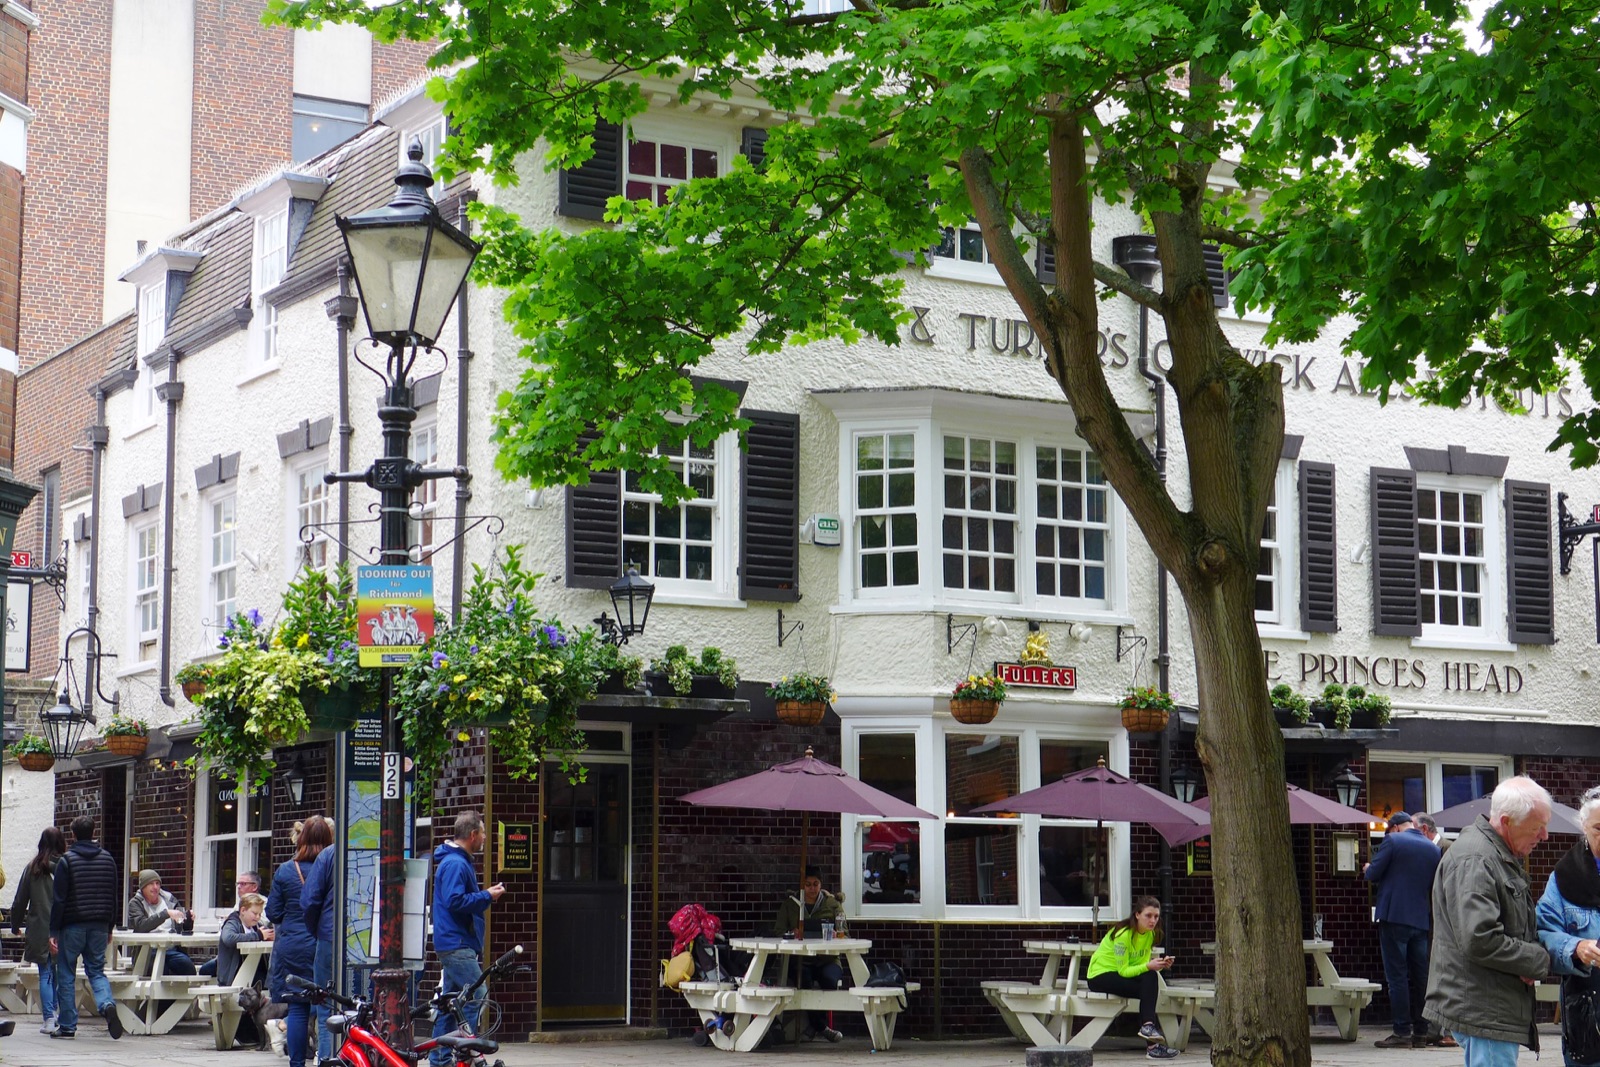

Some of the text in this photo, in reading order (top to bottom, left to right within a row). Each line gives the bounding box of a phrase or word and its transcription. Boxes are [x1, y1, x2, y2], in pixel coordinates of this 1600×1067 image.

[910, 305, 936, 344] &
[360, 570, 431, 578] LOOKING OUT
[369, 589, 422, 598] Richmond
[1003, 667, 1071, 685] FULLER'S
[1300, 653, 1427, 690] PRINCES
[1444, 661, 1524, 694] HEAD
